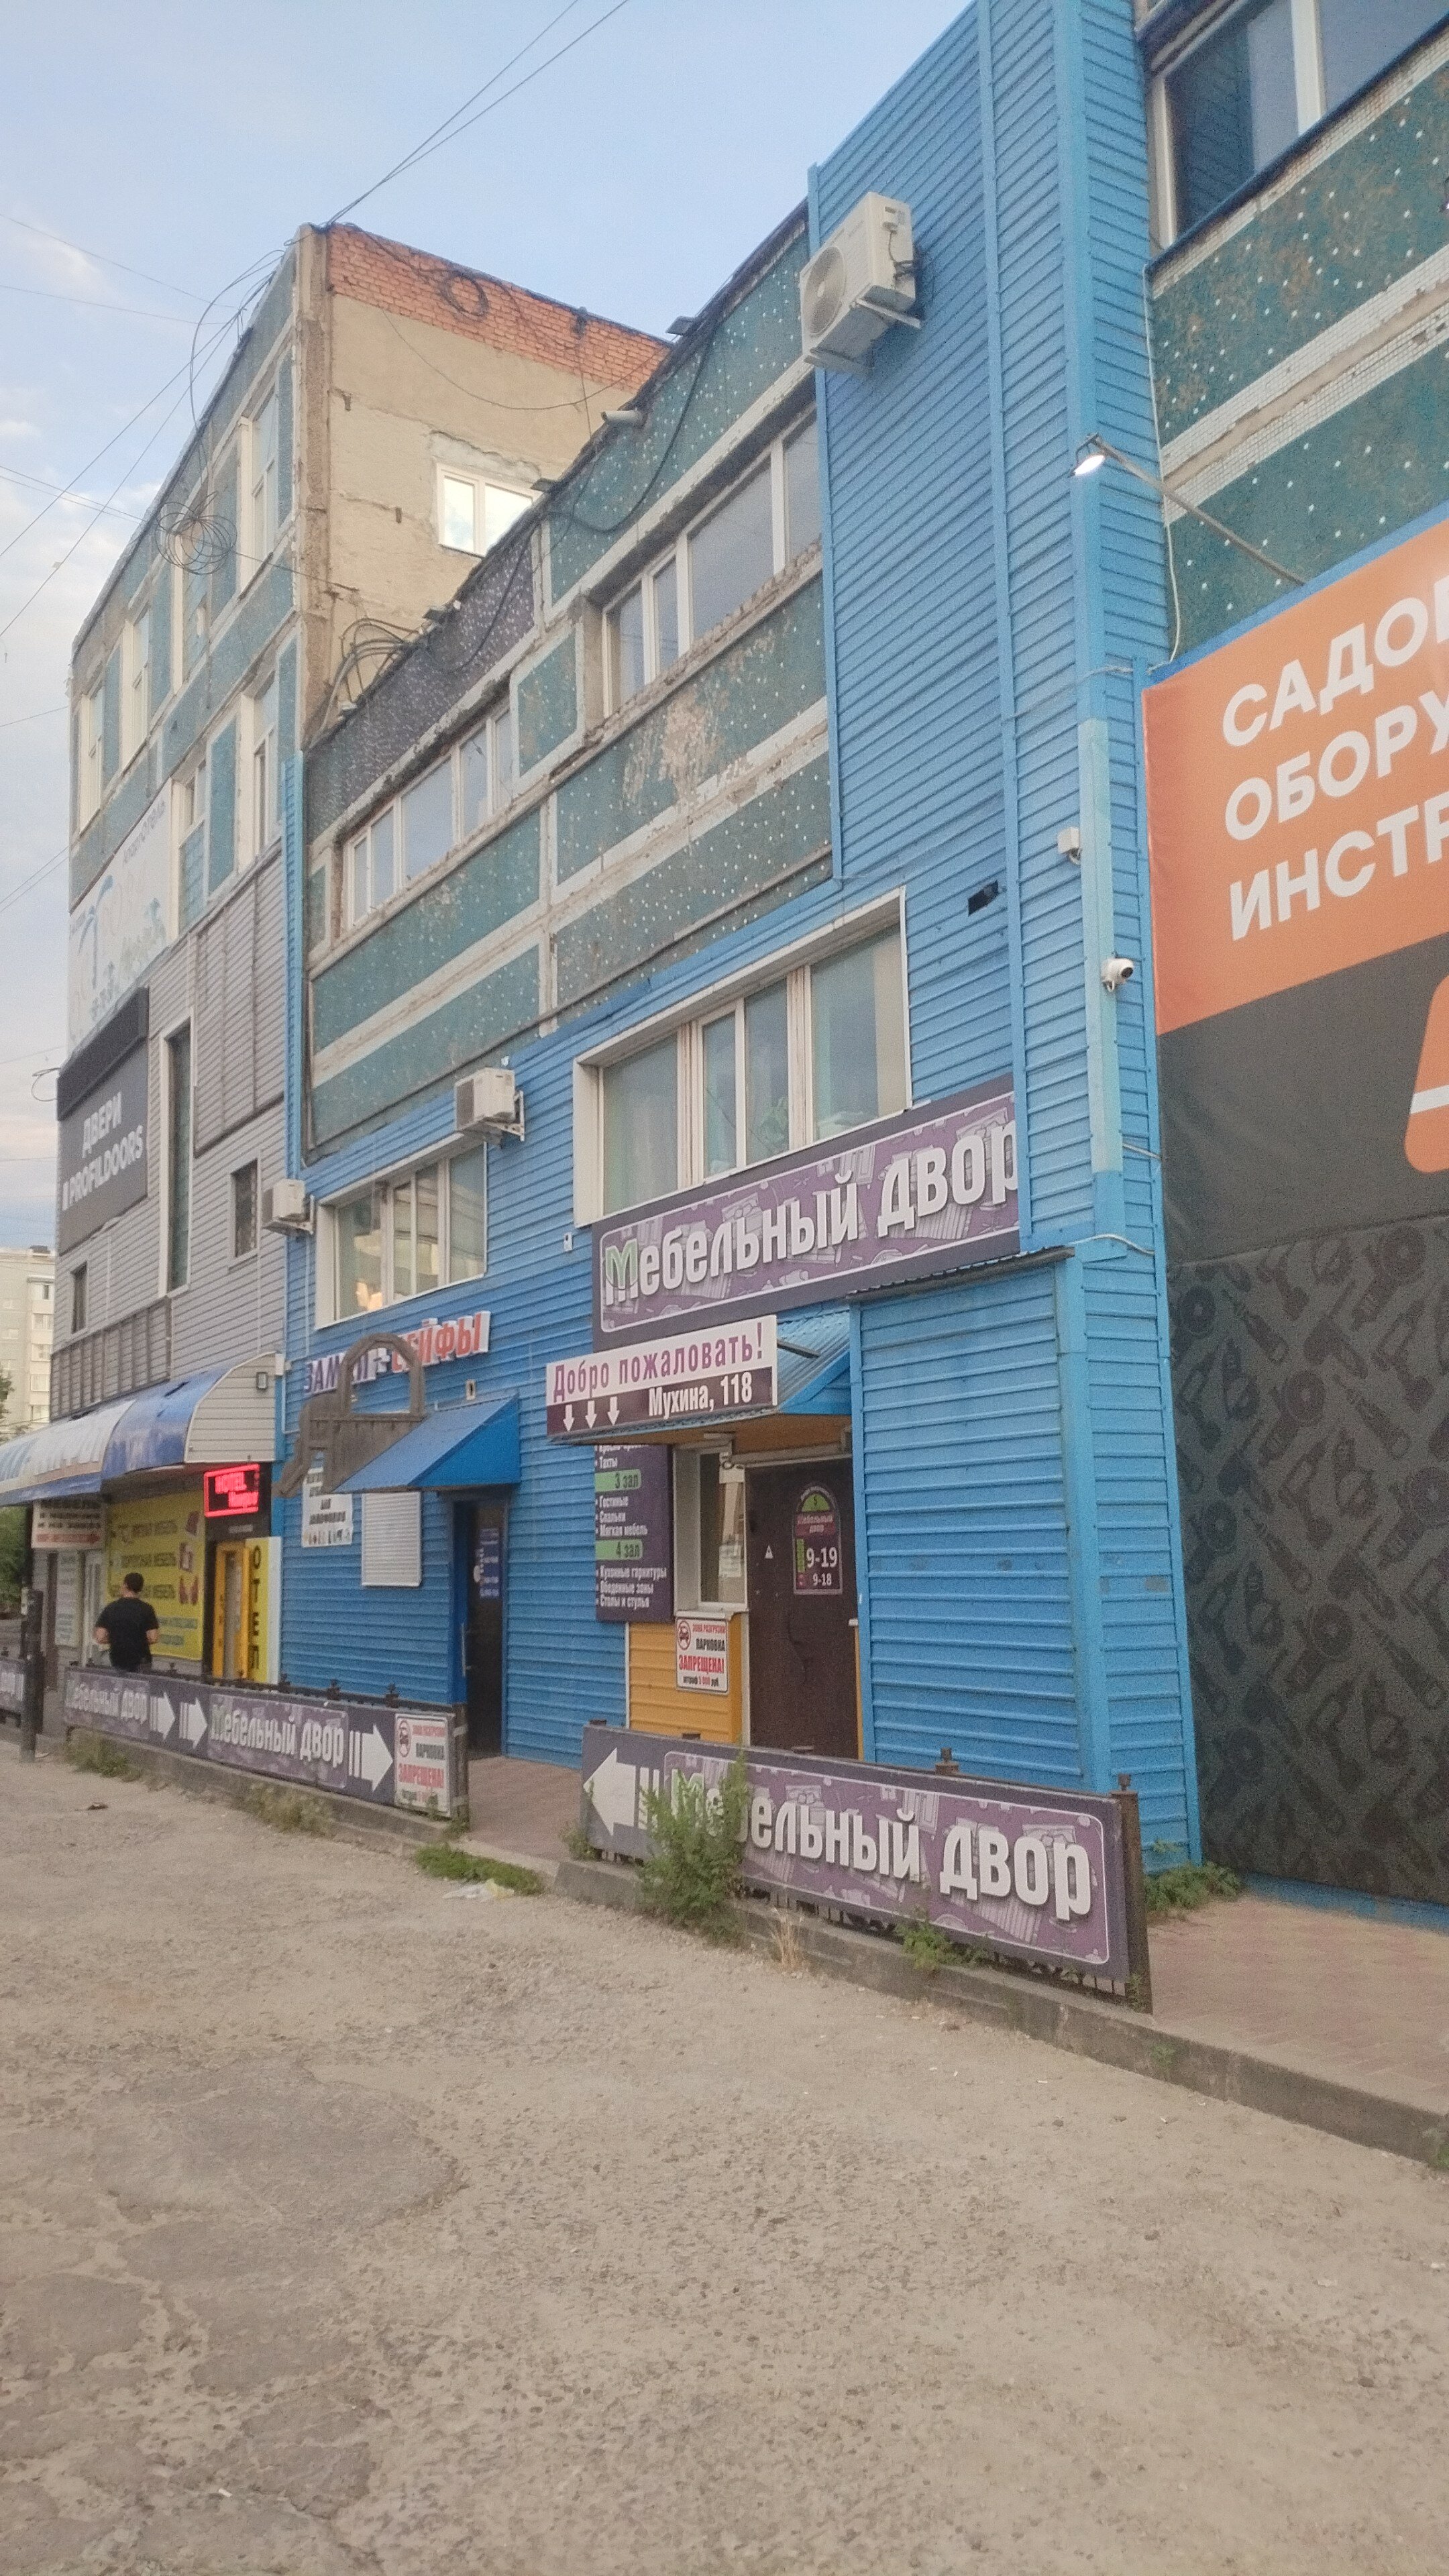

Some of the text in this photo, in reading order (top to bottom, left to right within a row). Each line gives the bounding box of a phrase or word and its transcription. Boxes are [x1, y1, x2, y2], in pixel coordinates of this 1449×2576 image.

[1225, 690, 1449, 841] ОБОРУ
[82, 1091, 122, 1159] ДВЕРИ
[605, 1169, 859, 1305] Мебельный
[553, 1322, 763, 1403] Добро пожаловать!
[649, 1372, 752, 1419] Мухина, 118
[614, 1472, 639, 1489] 3 зал
[616, 1542, 640, 1558] 4 зал
[806, 1546, 838, 1568] 9-19
[812, 1572, 833, 1587] 9-18
[679, 1654, 724, 1674] ЗАПРЕЩЕНА!
[671, 1768, 1092, 1921] Меельный двор
